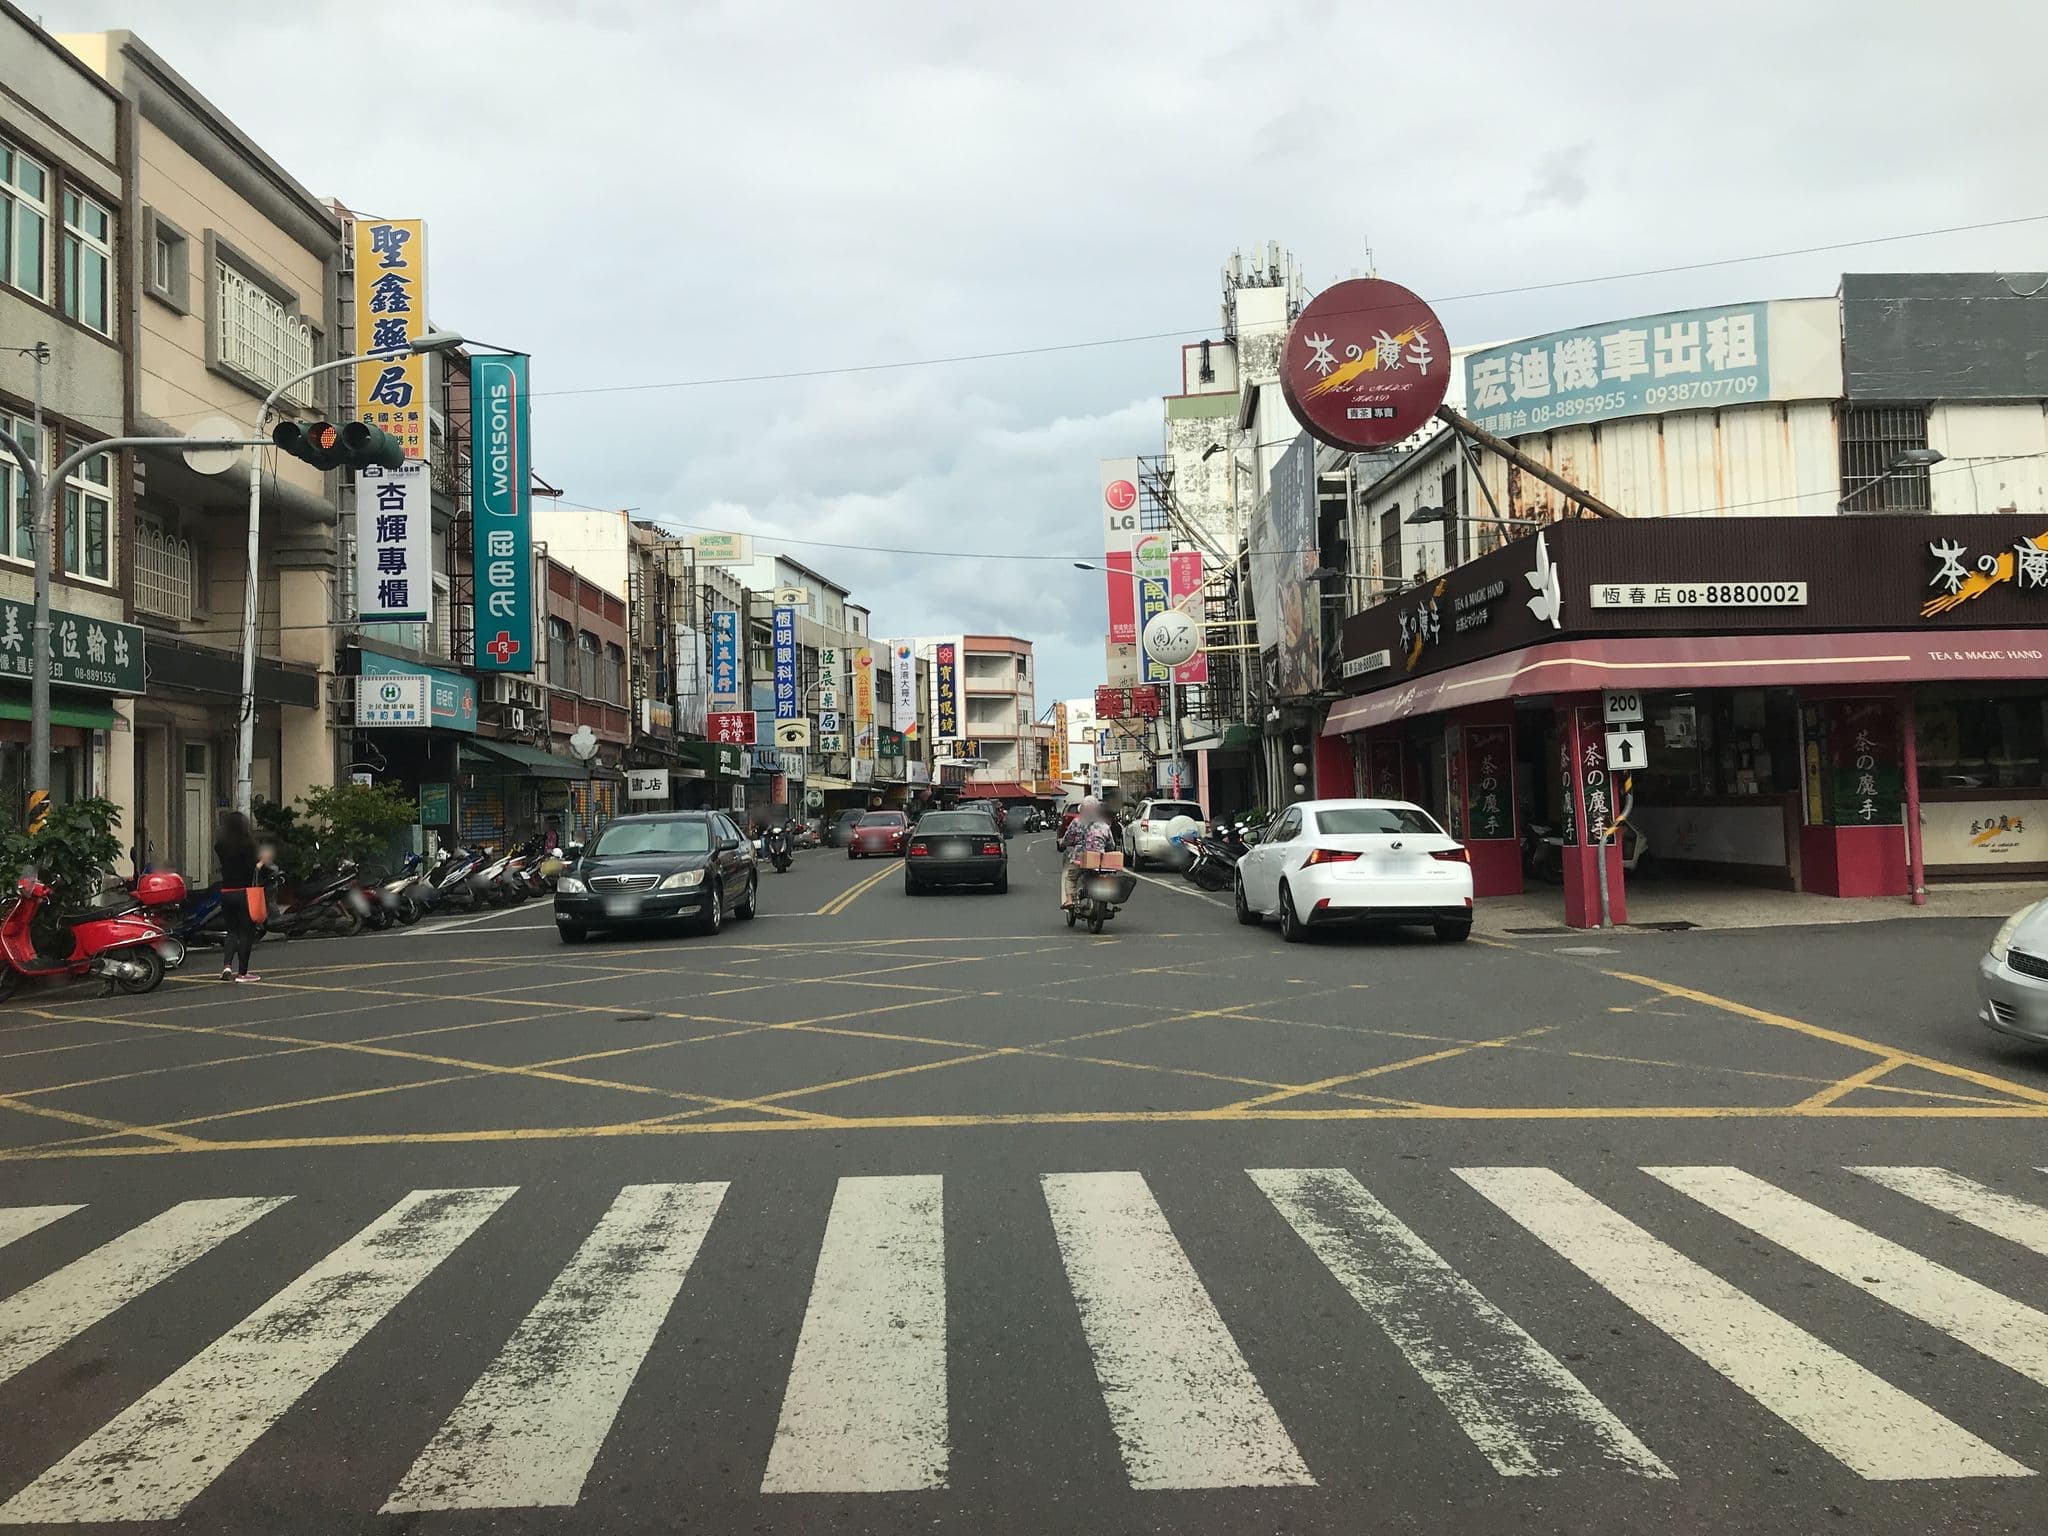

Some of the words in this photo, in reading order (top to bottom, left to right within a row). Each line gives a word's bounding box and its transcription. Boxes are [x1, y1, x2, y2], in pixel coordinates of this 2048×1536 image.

[367, 224, 413, 408] 聖鑫藥局
[1303, 328, 1434, 377] 茶の魔手
[1472, 313, 1758, 410] 宏迪機車出租
[1532, 391, 1626, 424] 08-8895955
[1645, 375, 1758, 405] 0938707709
[491, 384, 508, 497] watsons
[376, 482, 409, 610] 杏輝專櫃
[1110, 515, 1135, 531] LG
[1602, 585, 1672, 605] 恆春店
[1676, 584, 1800, 605] 08-8880002
[0, 605, 129, 668] 美位輸出
[776, 610, 794, 718] 恆明眼科診所
[1928, 651, 1951, 661] TEA
[1954, 651, 1963, 661] &
[1965, 651, 2005, 661] MAGIC
[2007, 650, 2043, 660] HAND
[1609, 695, 1637, 713] 200
[1855, 730, 1878, 821] 茶の魔手
